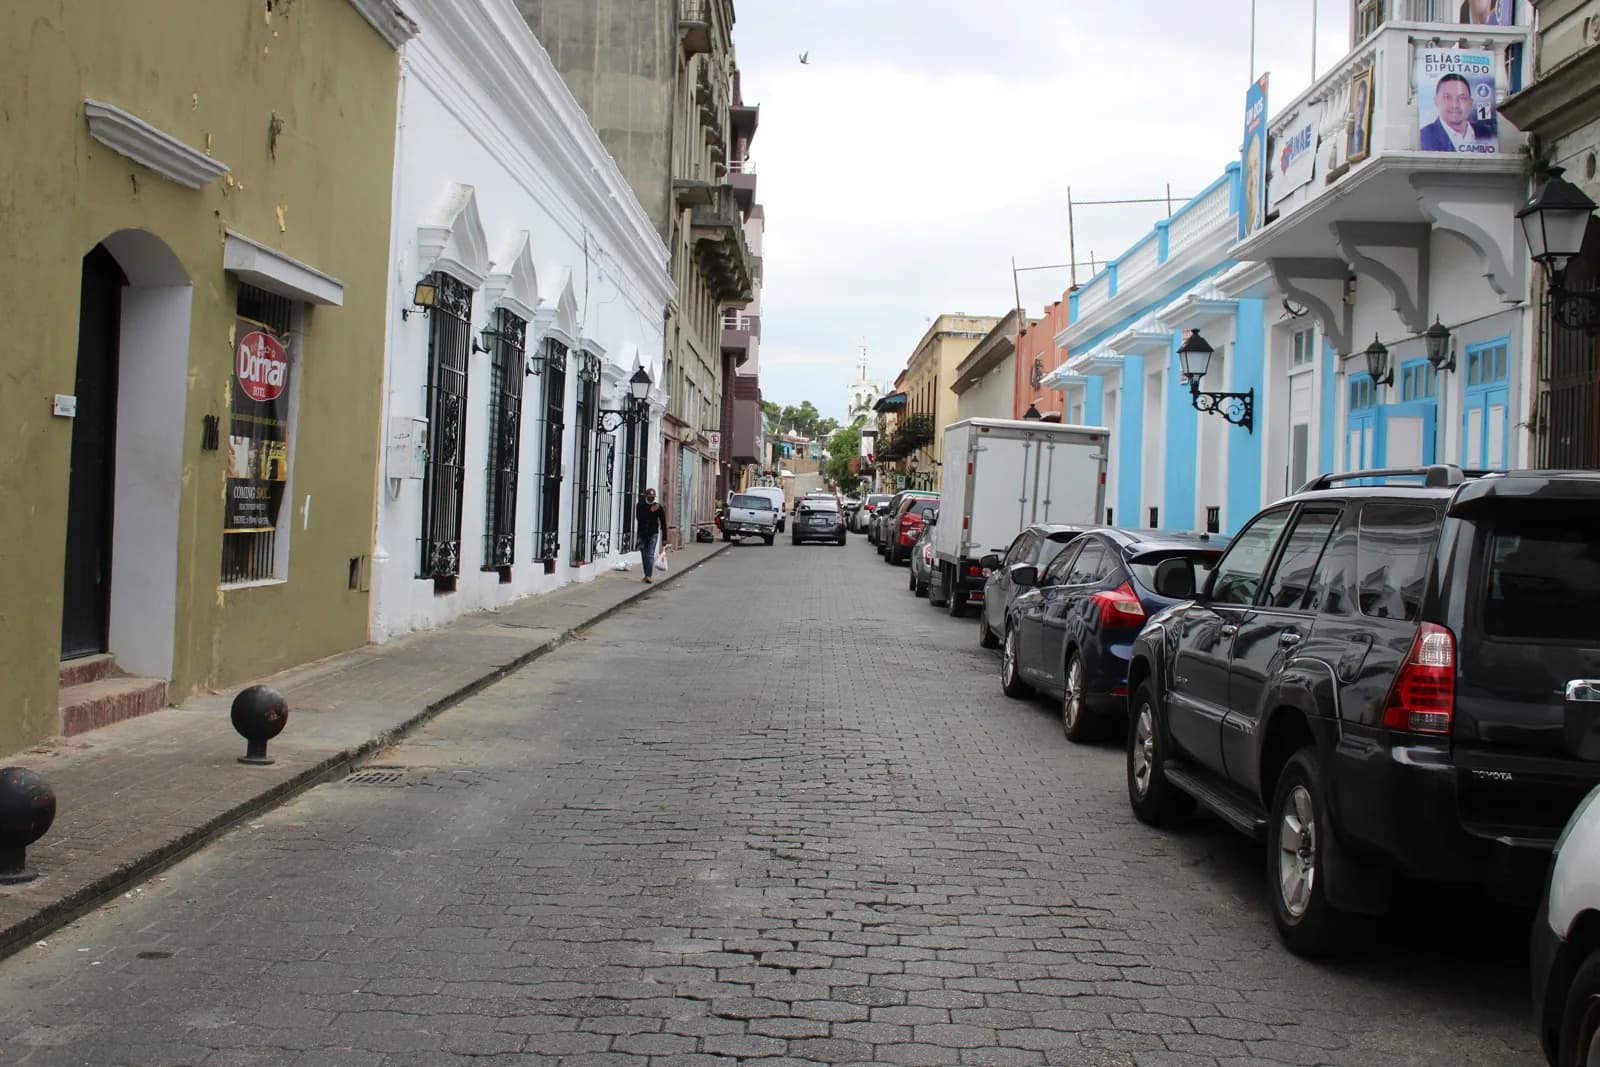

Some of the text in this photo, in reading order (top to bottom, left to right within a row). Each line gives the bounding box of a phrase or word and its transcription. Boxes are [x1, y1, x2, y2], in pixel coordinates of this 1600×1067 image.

[1425, 64, 1489, 73] DIPUTADO
[1458, 144, 1496, 153] CAMBIO
[233, 486, 256, 499] COMING
[1471, 770, 1512, 780] TOYOTA
